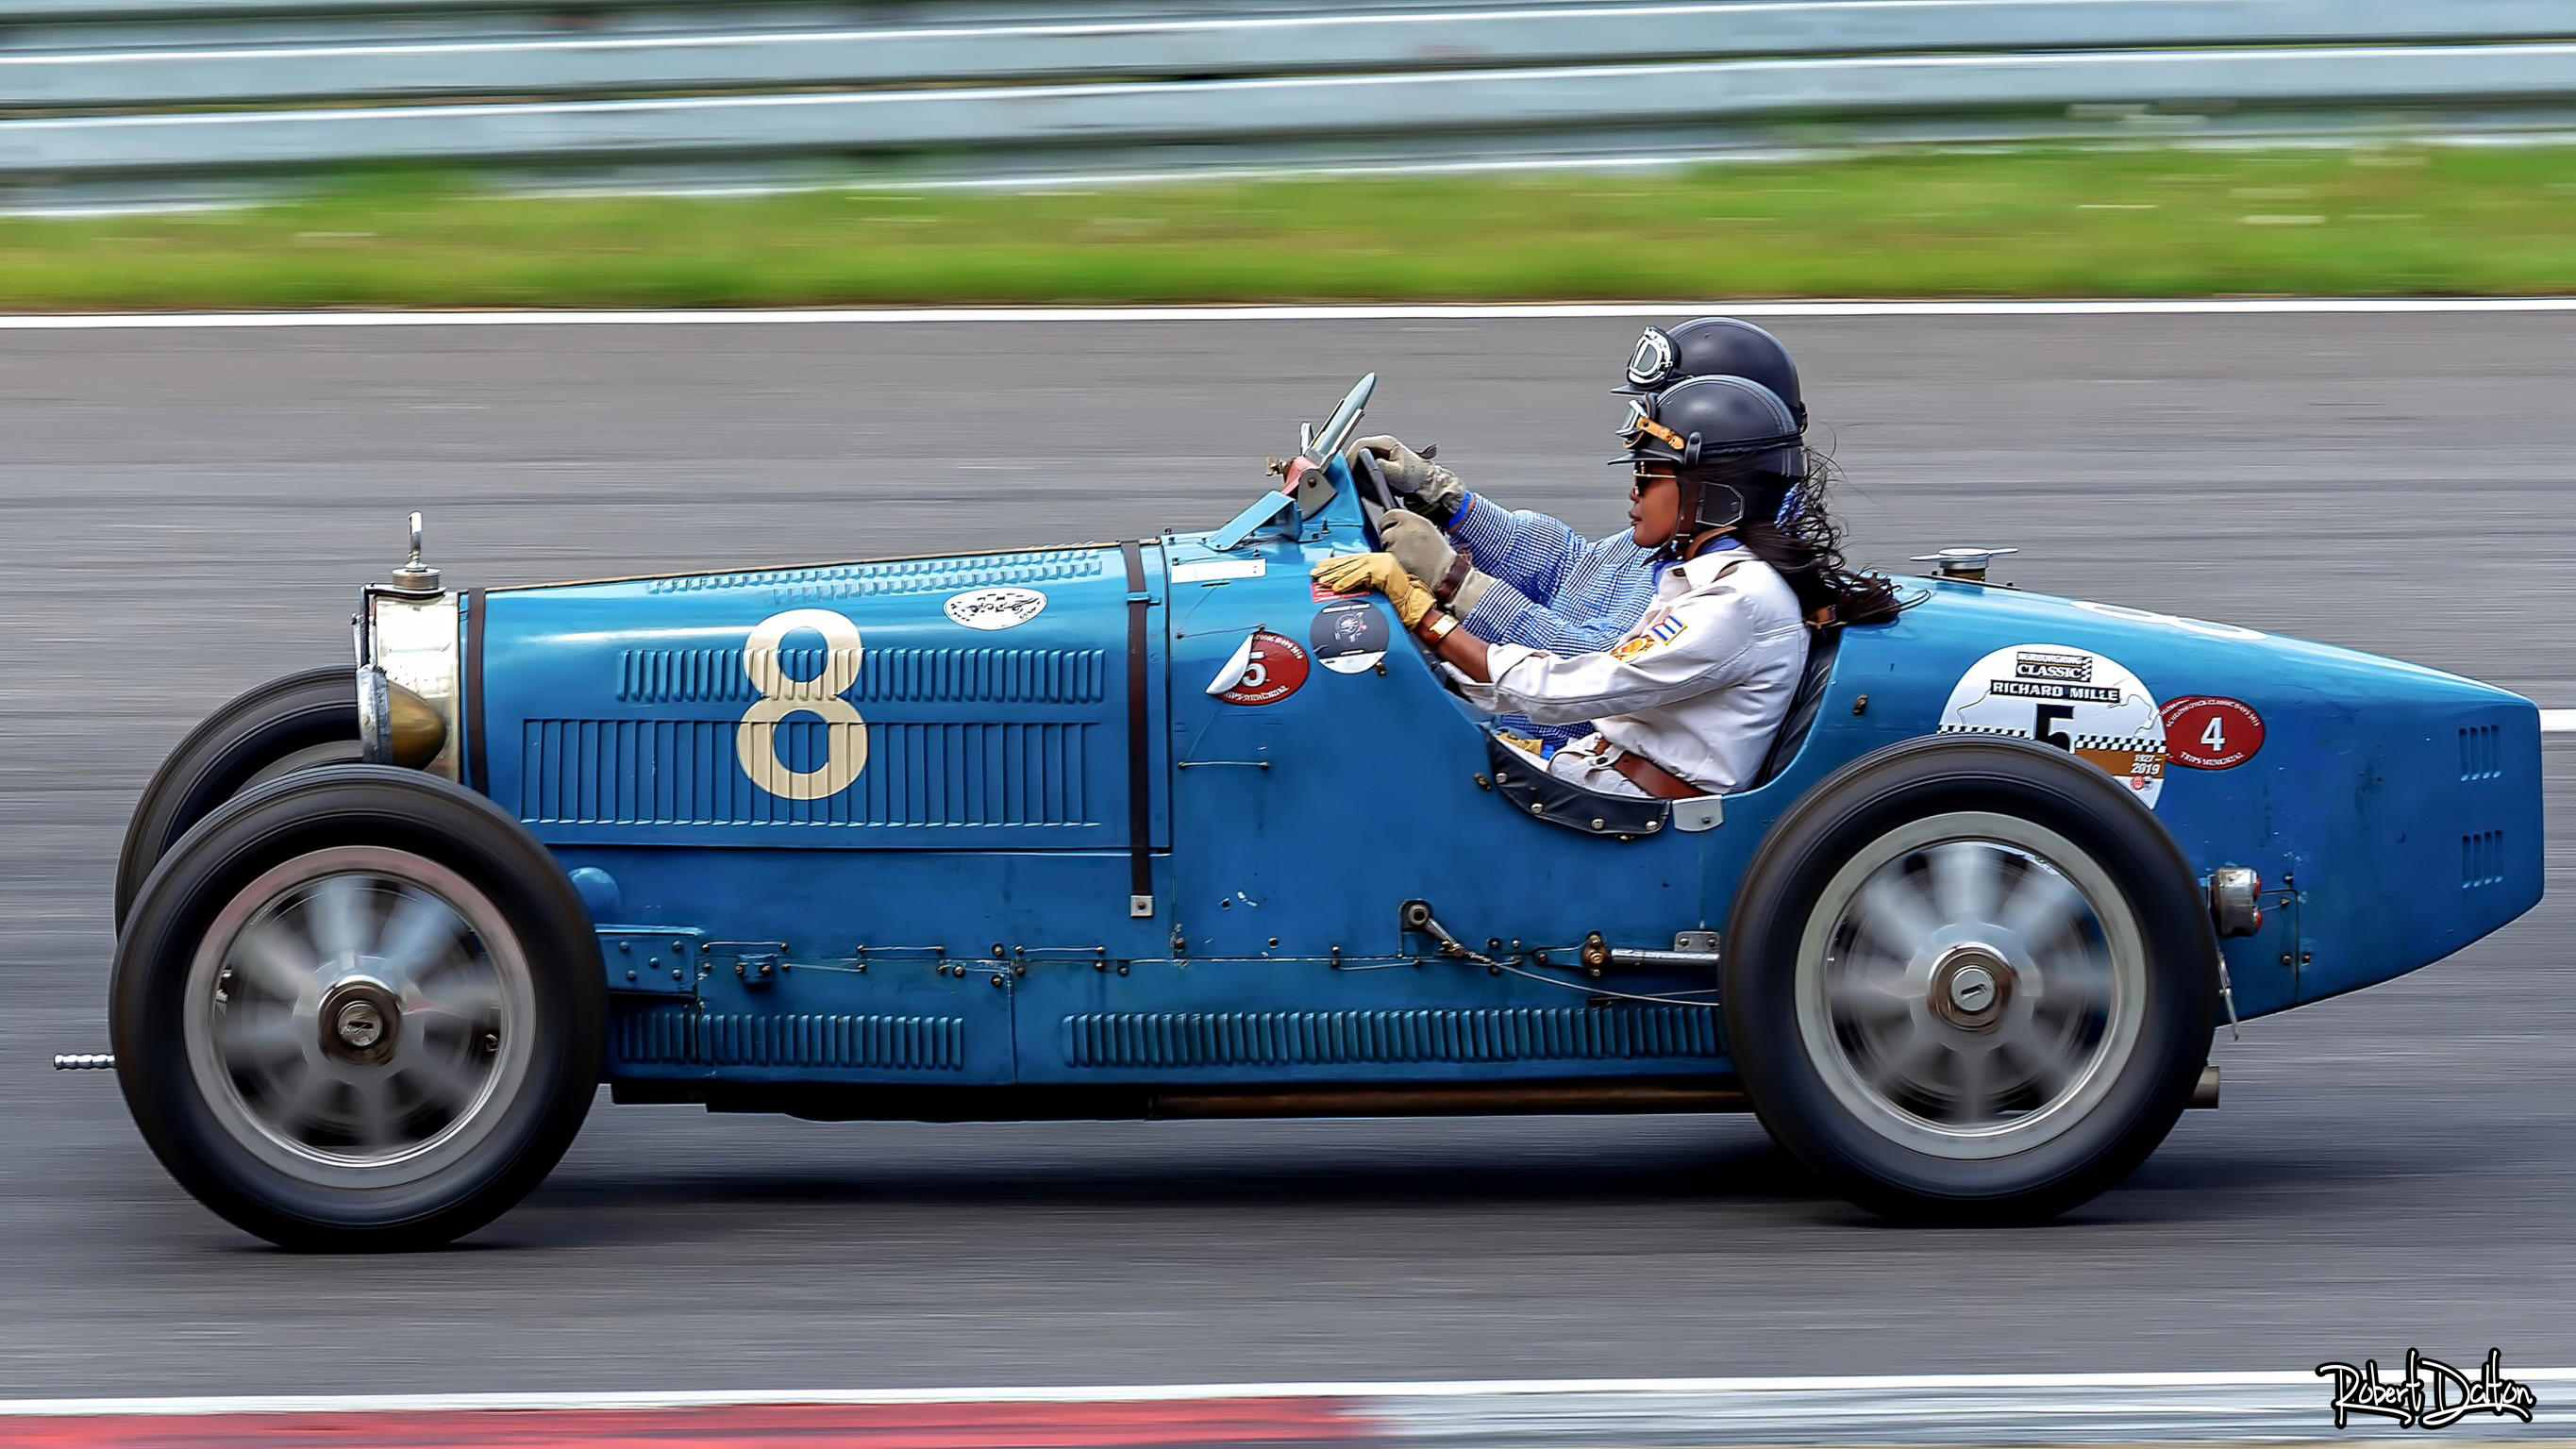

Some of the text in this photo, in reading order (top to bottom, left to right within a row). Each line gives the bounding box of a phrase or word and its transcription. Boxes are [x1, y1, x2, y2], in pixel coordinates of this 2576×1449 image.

[1242, 651, 1267, 688] 5
[2016, 663, 2083, 678] CLASSIC
[736, 608, 868, 801] 8
[1992, 681, 2119, 701] RICHARD MILLE
[2035, 703, 2075, 754] 5
[2200, 716, 2226, 752] 4
[2130, 762, 2162, 775] 2019
